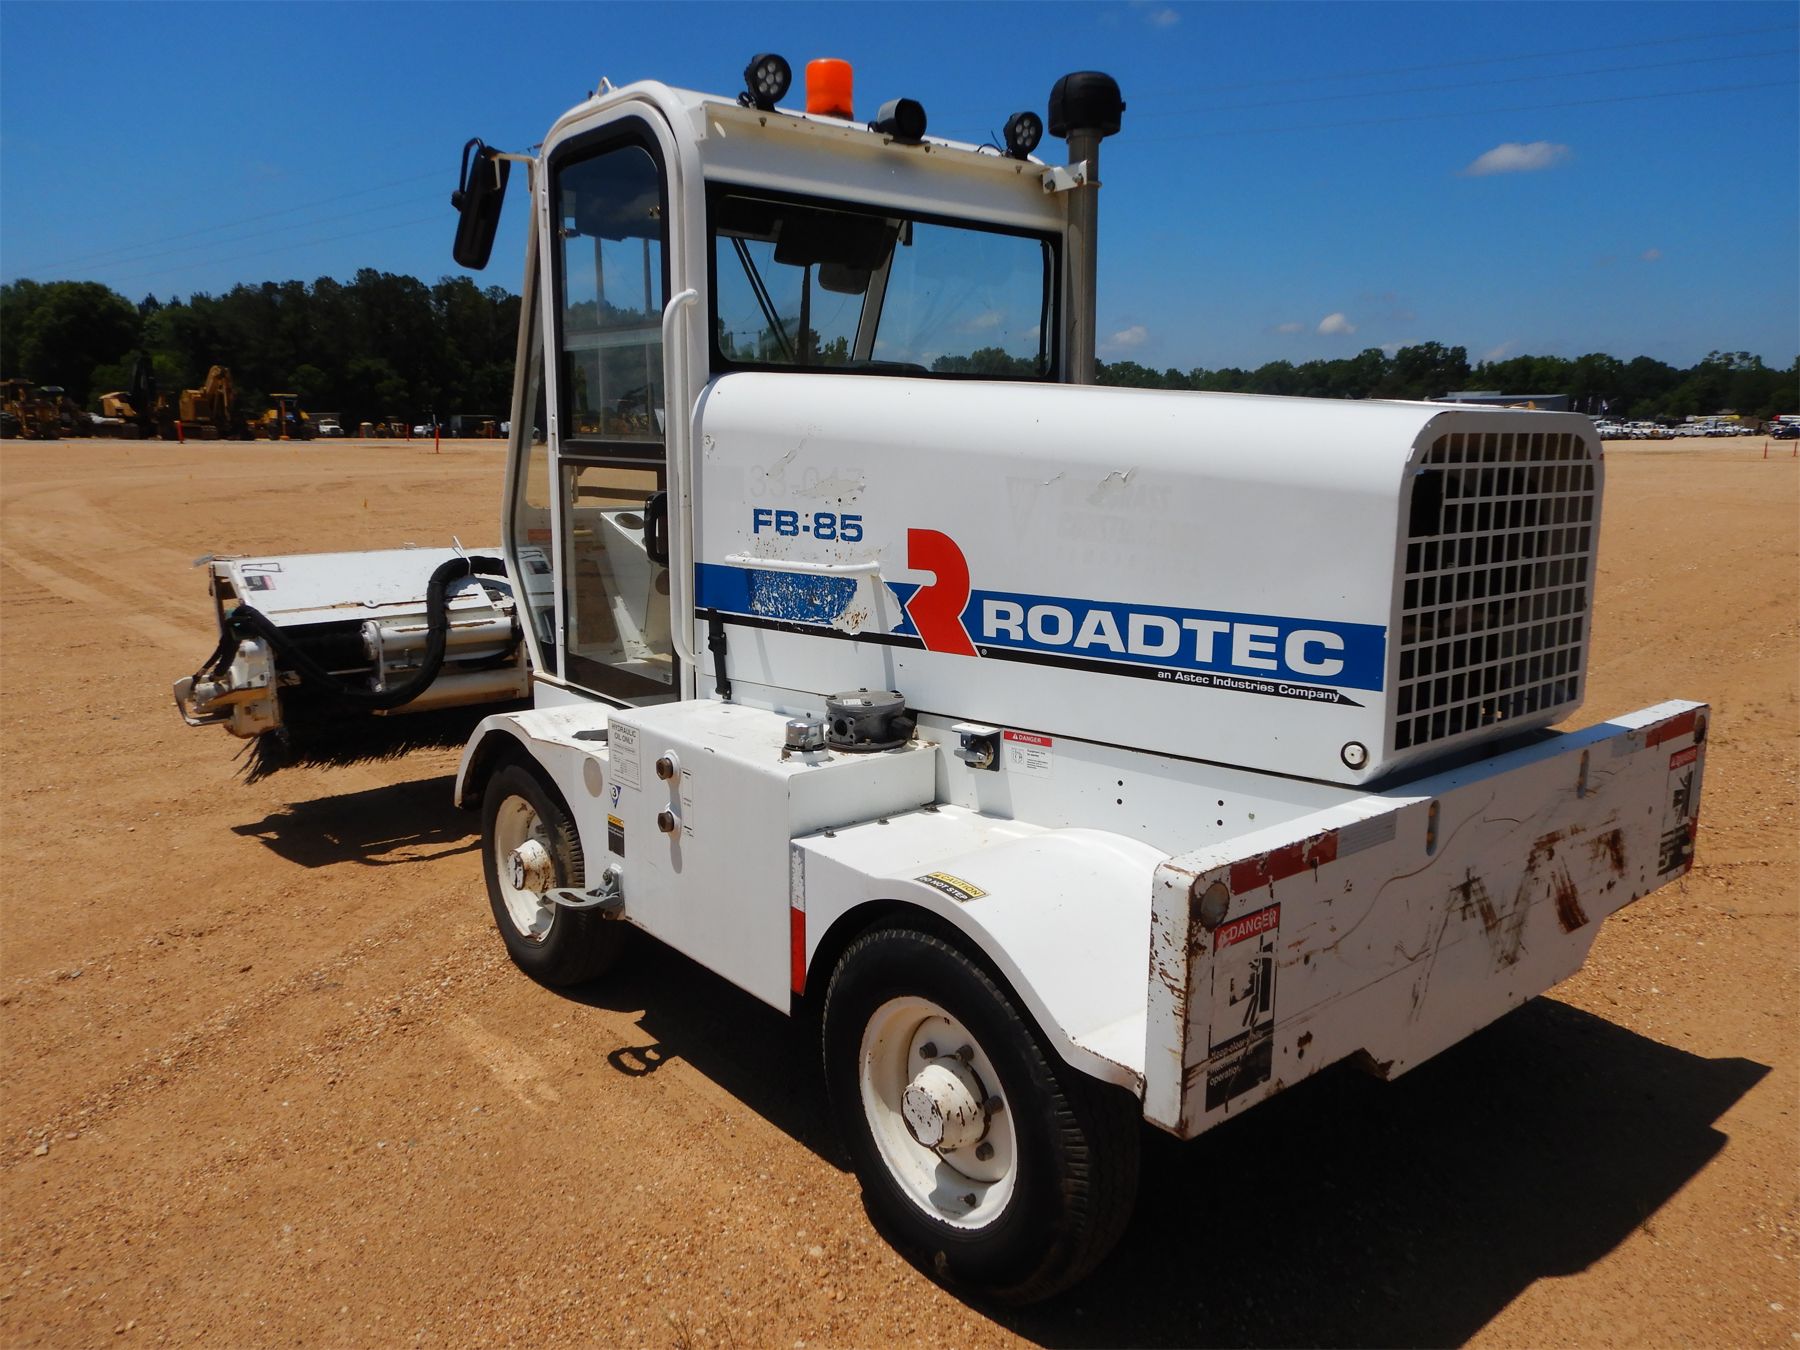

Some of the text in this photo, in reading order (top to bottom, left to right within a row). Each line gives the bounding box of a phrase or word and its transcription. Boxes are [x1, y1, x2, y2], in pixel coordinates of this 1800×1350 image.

[753, 508, 863, 542] FB-85
[983, 599, 1345, 677] ROADTEC
[1157, 670, 1340, 703] an Astec Industries Company
[612, 723, 637, 738] HYDRAULIC
[1018, 734, 1042, 743] DANGER
[930, 879, 950, 889] NOT
[946, 886, 969, 900] STEP
[941, 875, 980, 896] CAUTION
[1230, 909, 1277, 940] DANGER
